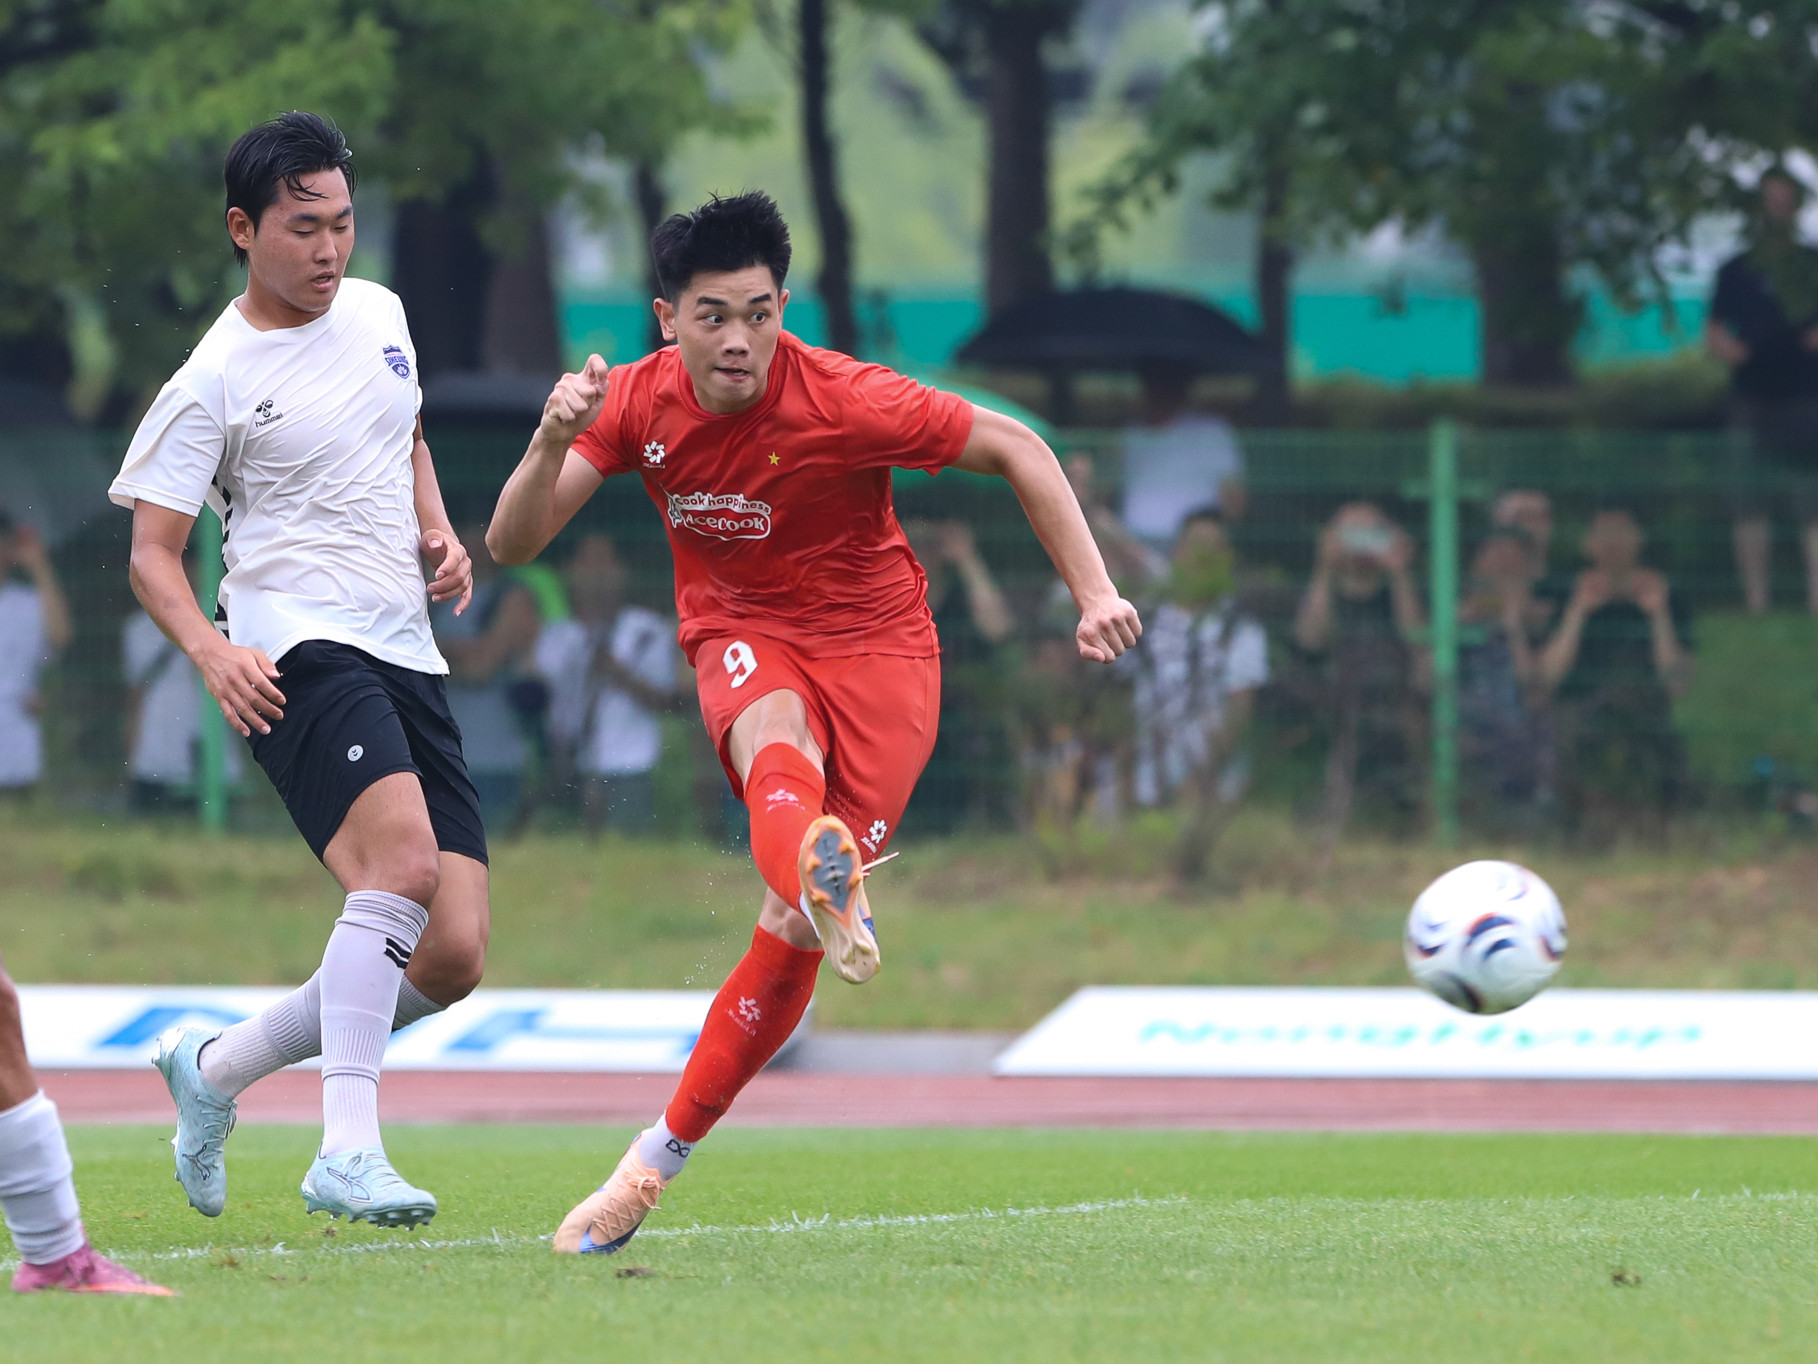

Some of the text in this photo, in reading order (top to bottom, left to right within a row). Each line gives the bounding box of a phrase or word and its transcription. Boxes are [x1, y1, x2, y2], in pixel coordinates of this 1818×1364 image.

[255, 413, 283, 428] hummel
[708, 494, 769, 514] happiness
[722, 640, 759, 689] 9
